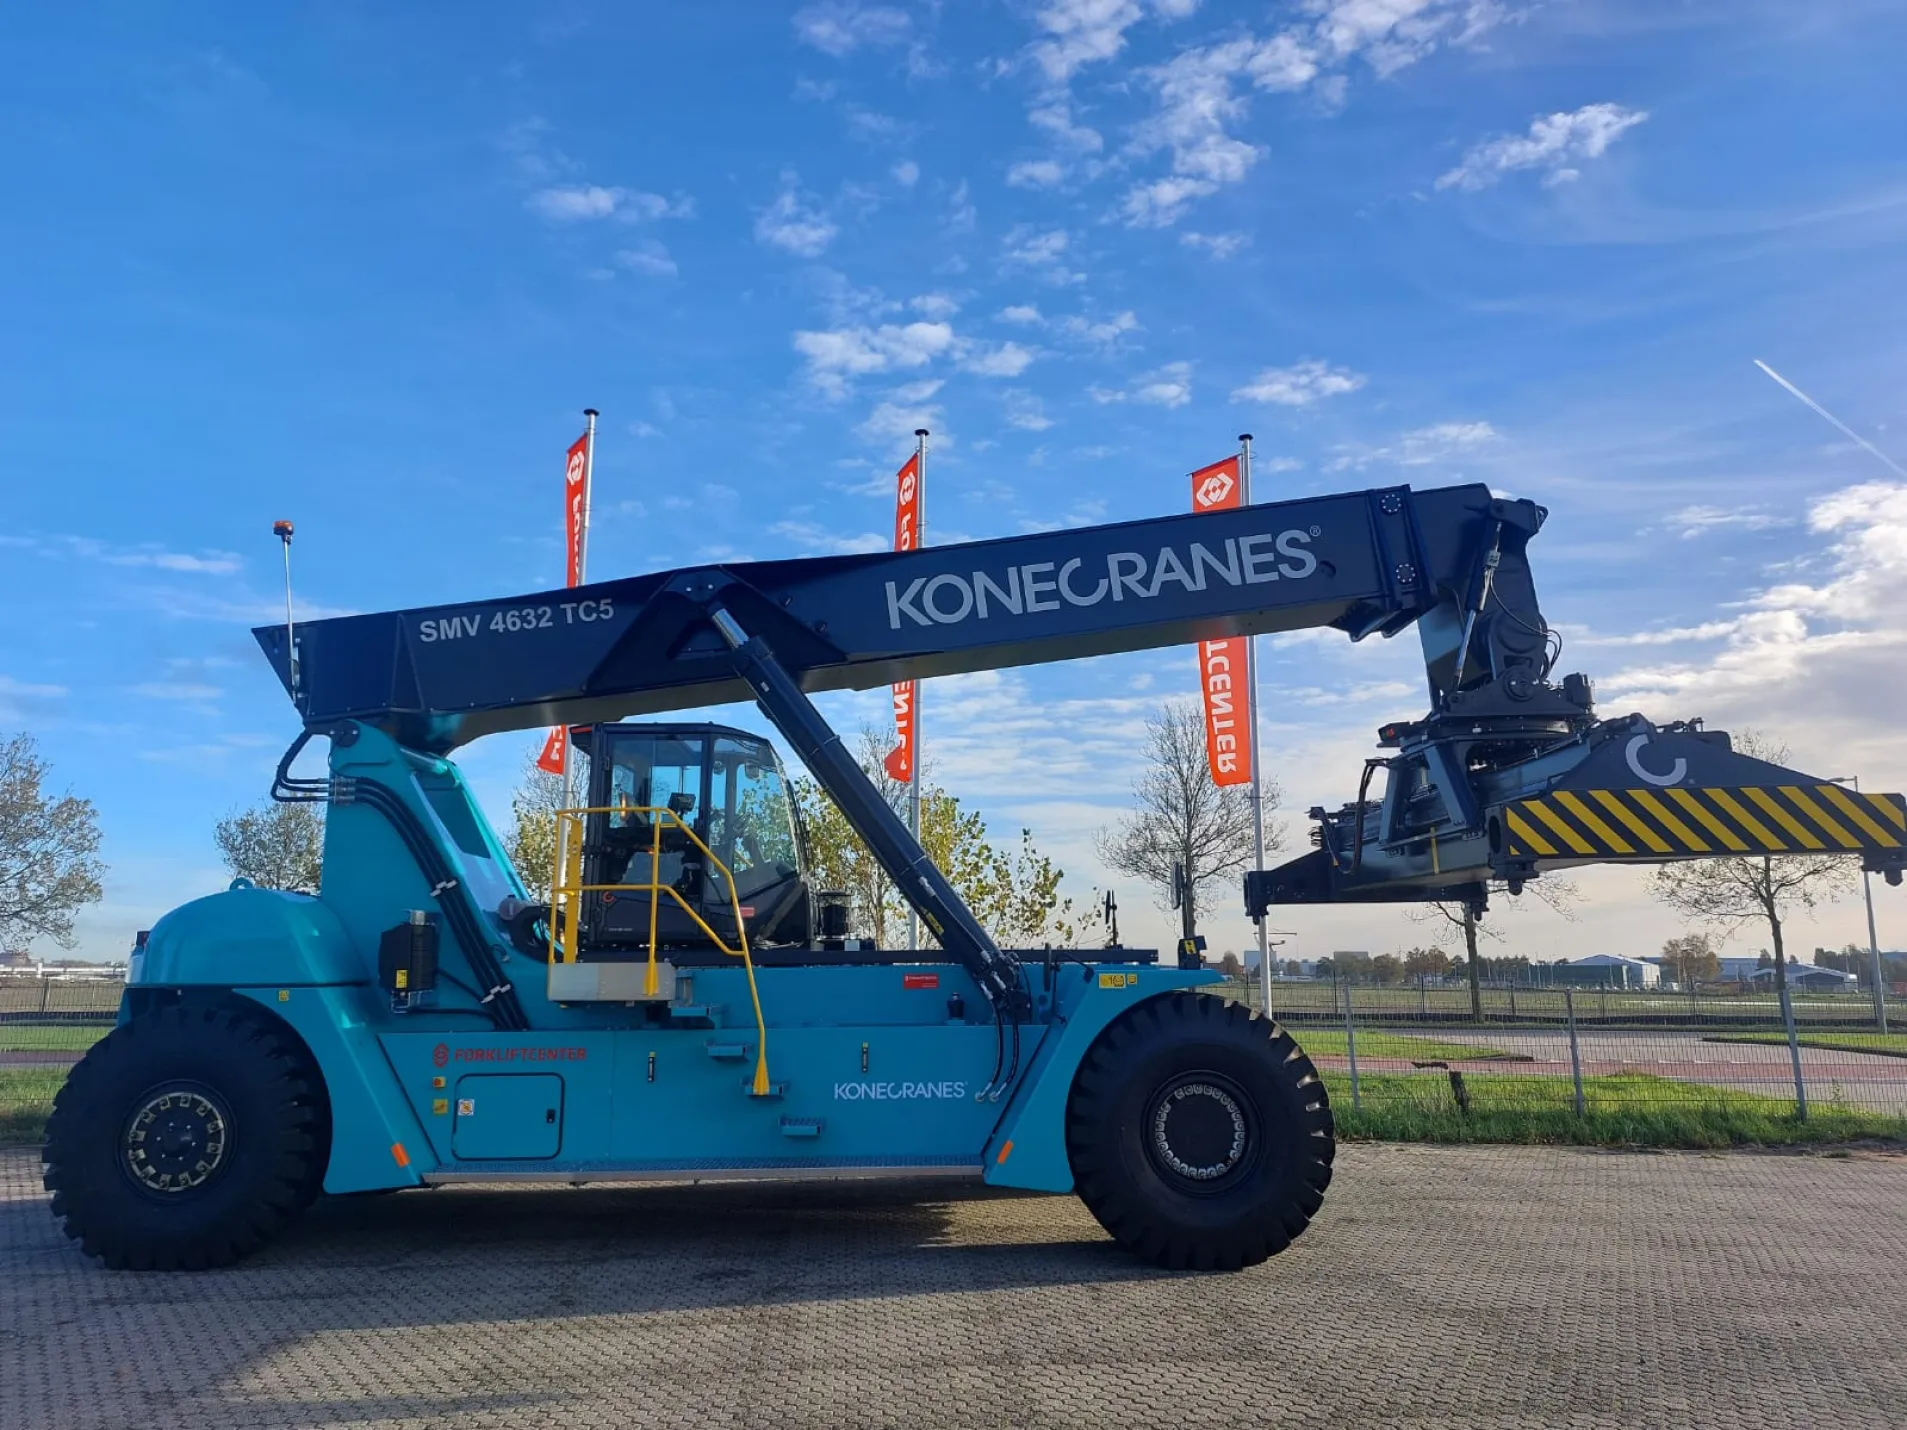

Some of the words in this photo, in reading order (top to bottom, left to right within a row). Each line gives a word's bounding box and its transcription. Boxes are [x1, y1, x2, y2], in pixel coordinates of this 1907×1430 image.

[420, 614, 481, 642] SMV
[490, 606, 553, 633] 4632
[560, 598, 615, 624] TC5
[454, 1047, 587, 1062] FORKLIFTCENTER
